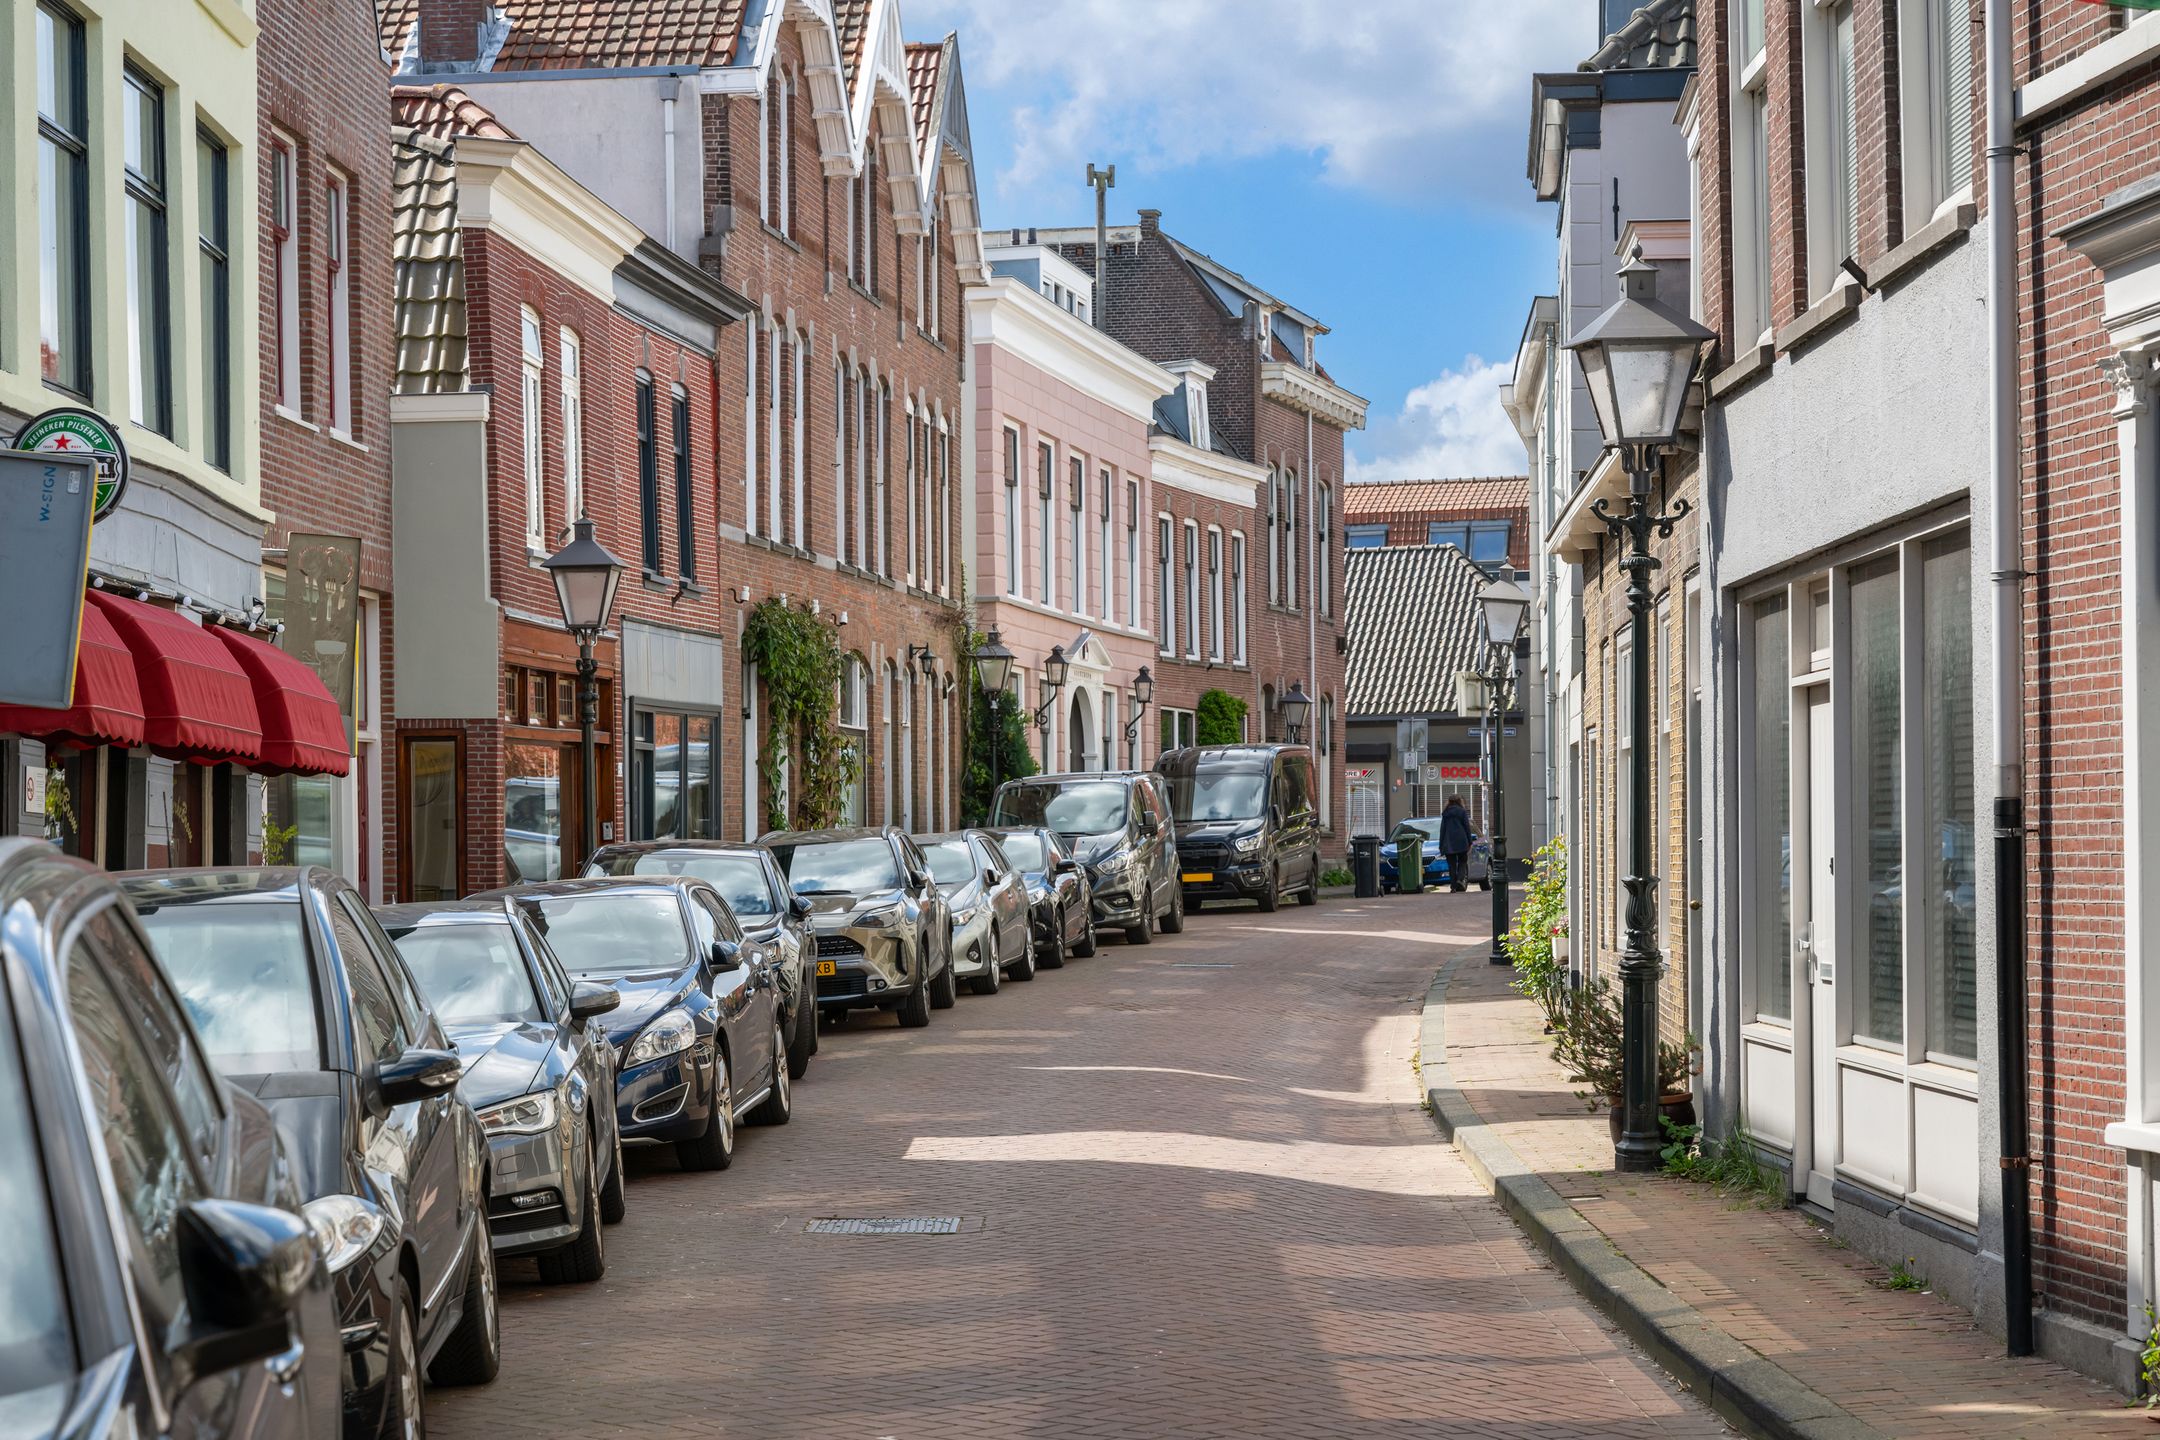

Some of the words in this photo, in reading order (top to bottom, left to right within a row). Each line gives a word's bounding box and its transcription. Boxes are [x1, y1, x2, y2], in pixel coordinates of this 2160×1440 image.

[28, 420, 65, 446] HEINEKEN
[67, 420, 103, 445] PILSENER
[40, 466, 57, 522] W-SIGN
